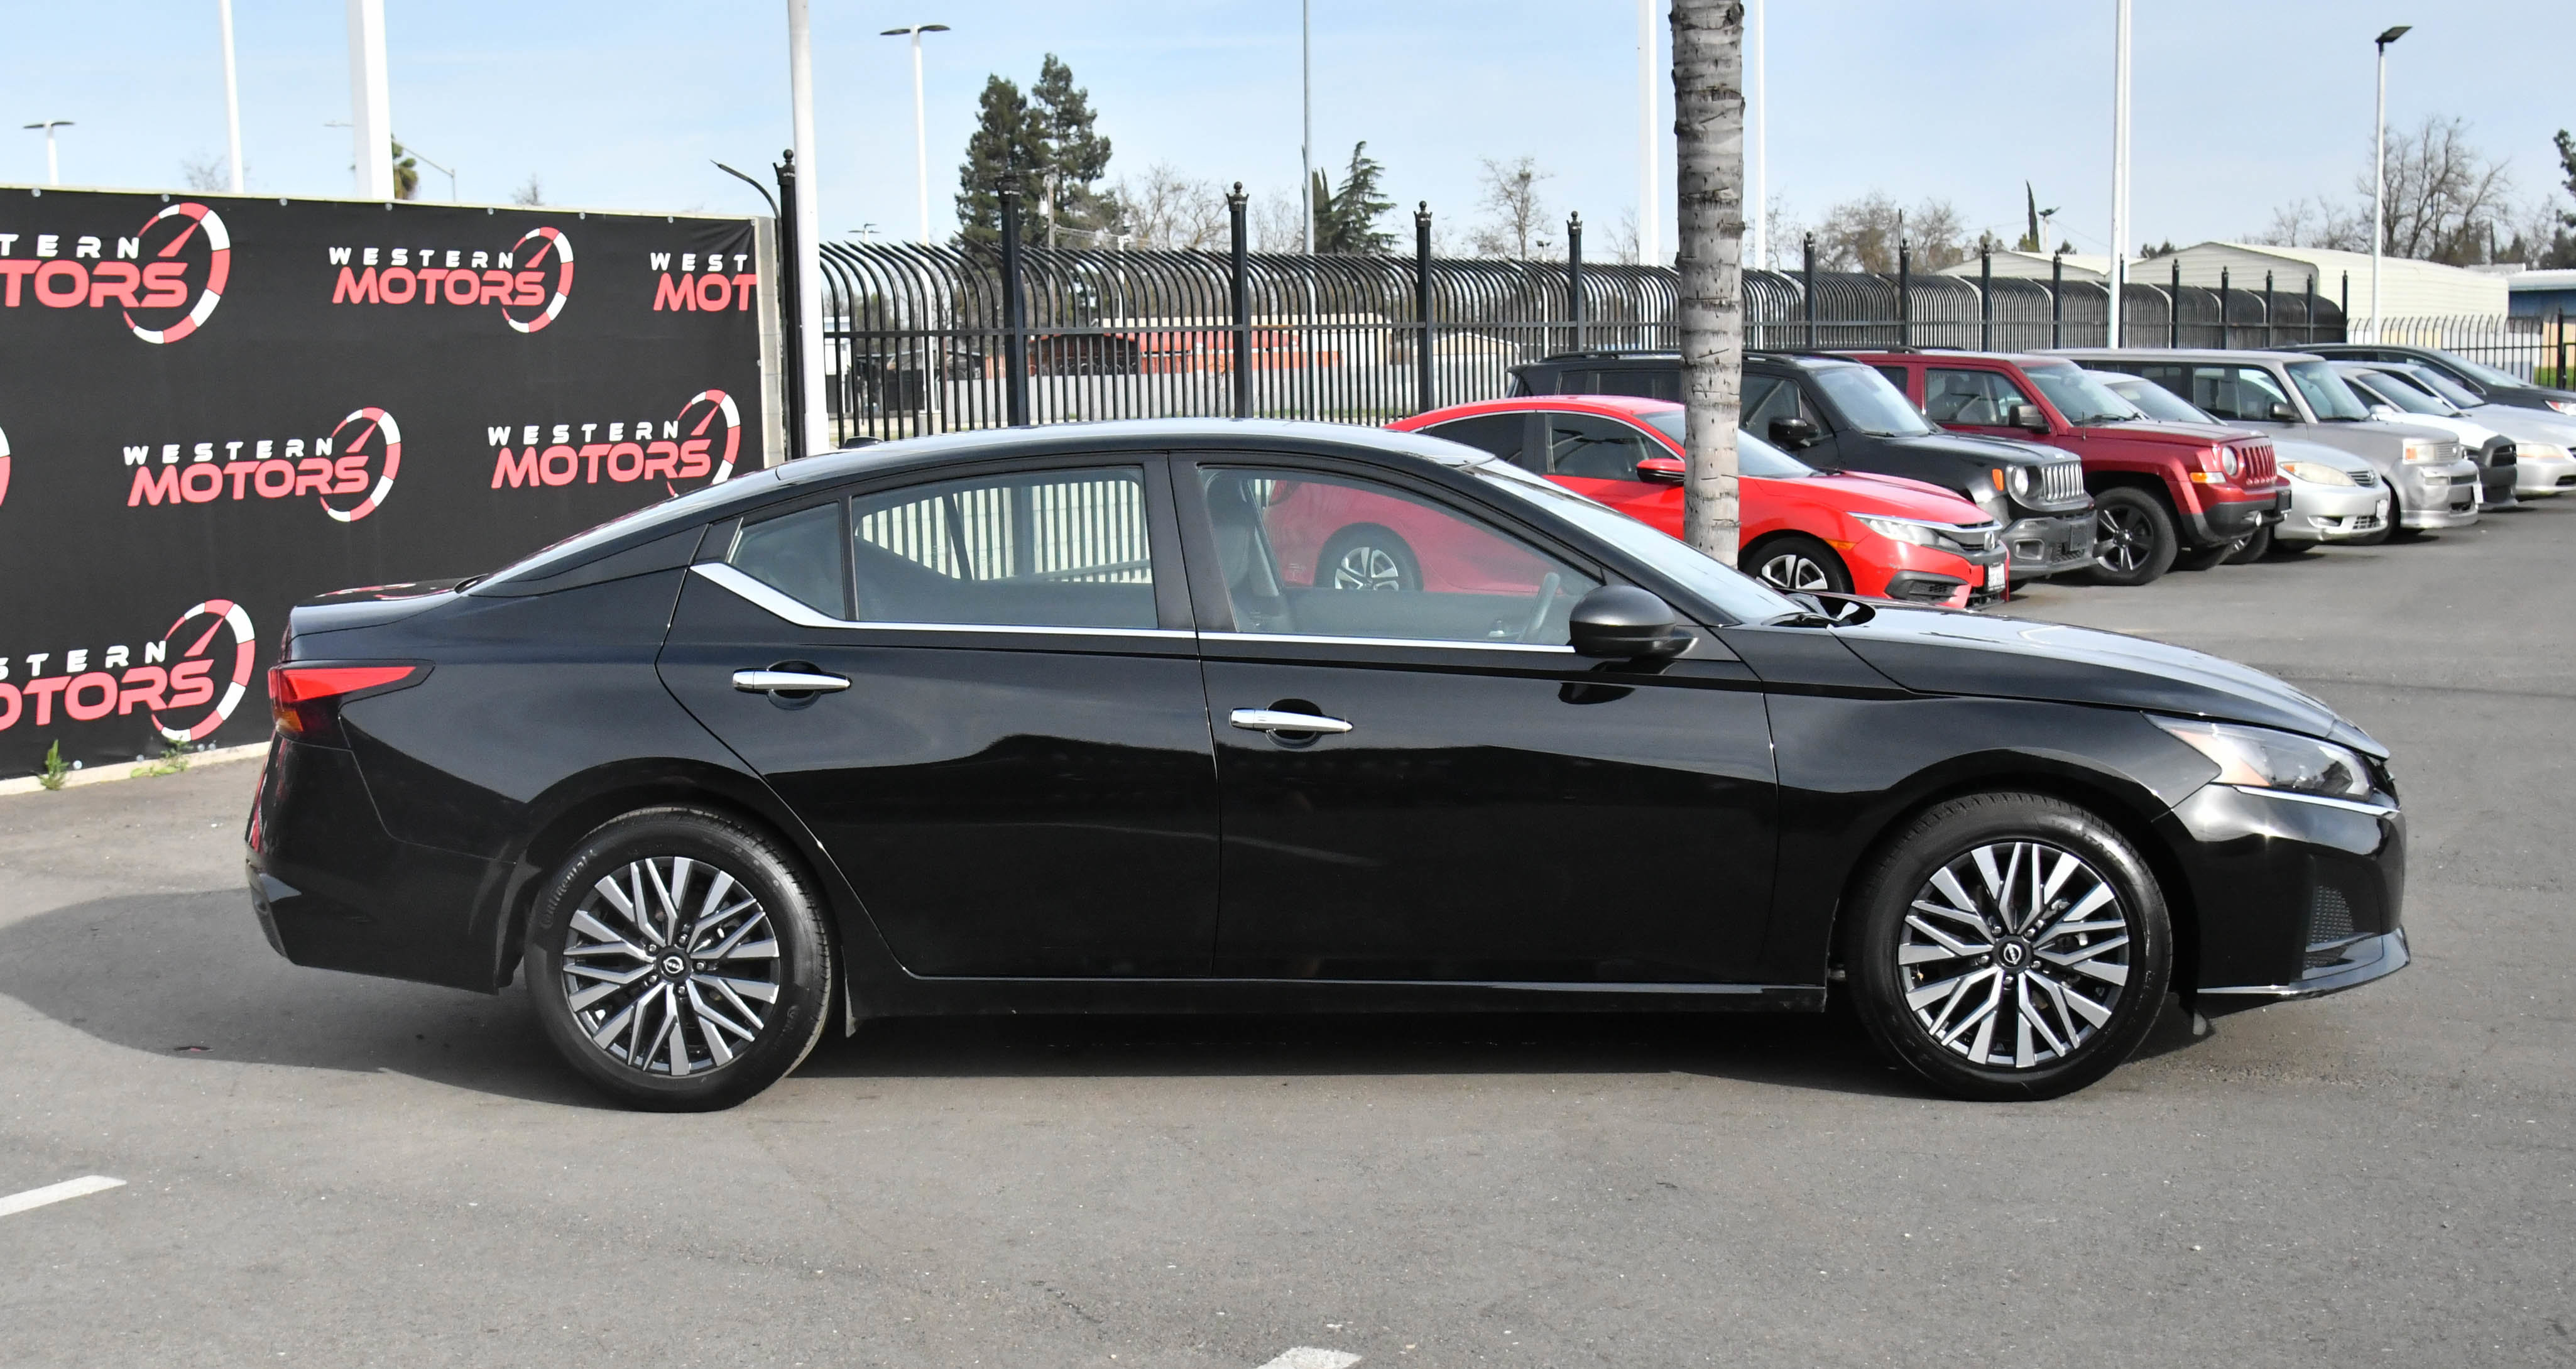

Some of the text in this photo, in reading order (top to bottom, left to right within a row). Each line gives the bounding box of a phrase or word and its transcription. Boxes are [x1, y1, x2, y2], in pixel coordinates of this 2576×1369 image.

[329, 247, 513, 269] WESTERN
[650, 252, 748, 272] WEST
[0, 259, 188, 308] TORS
[332, 266, 545, 305] MOTORS
[653, 273, 757, 312] MOT
[123, 437, 333, 466] WESTERN
[488, 420, 679, 447] WESTERN
[127, 455, 369, 507] MOTORS
[491, 439, 711, 489] MOTORS
